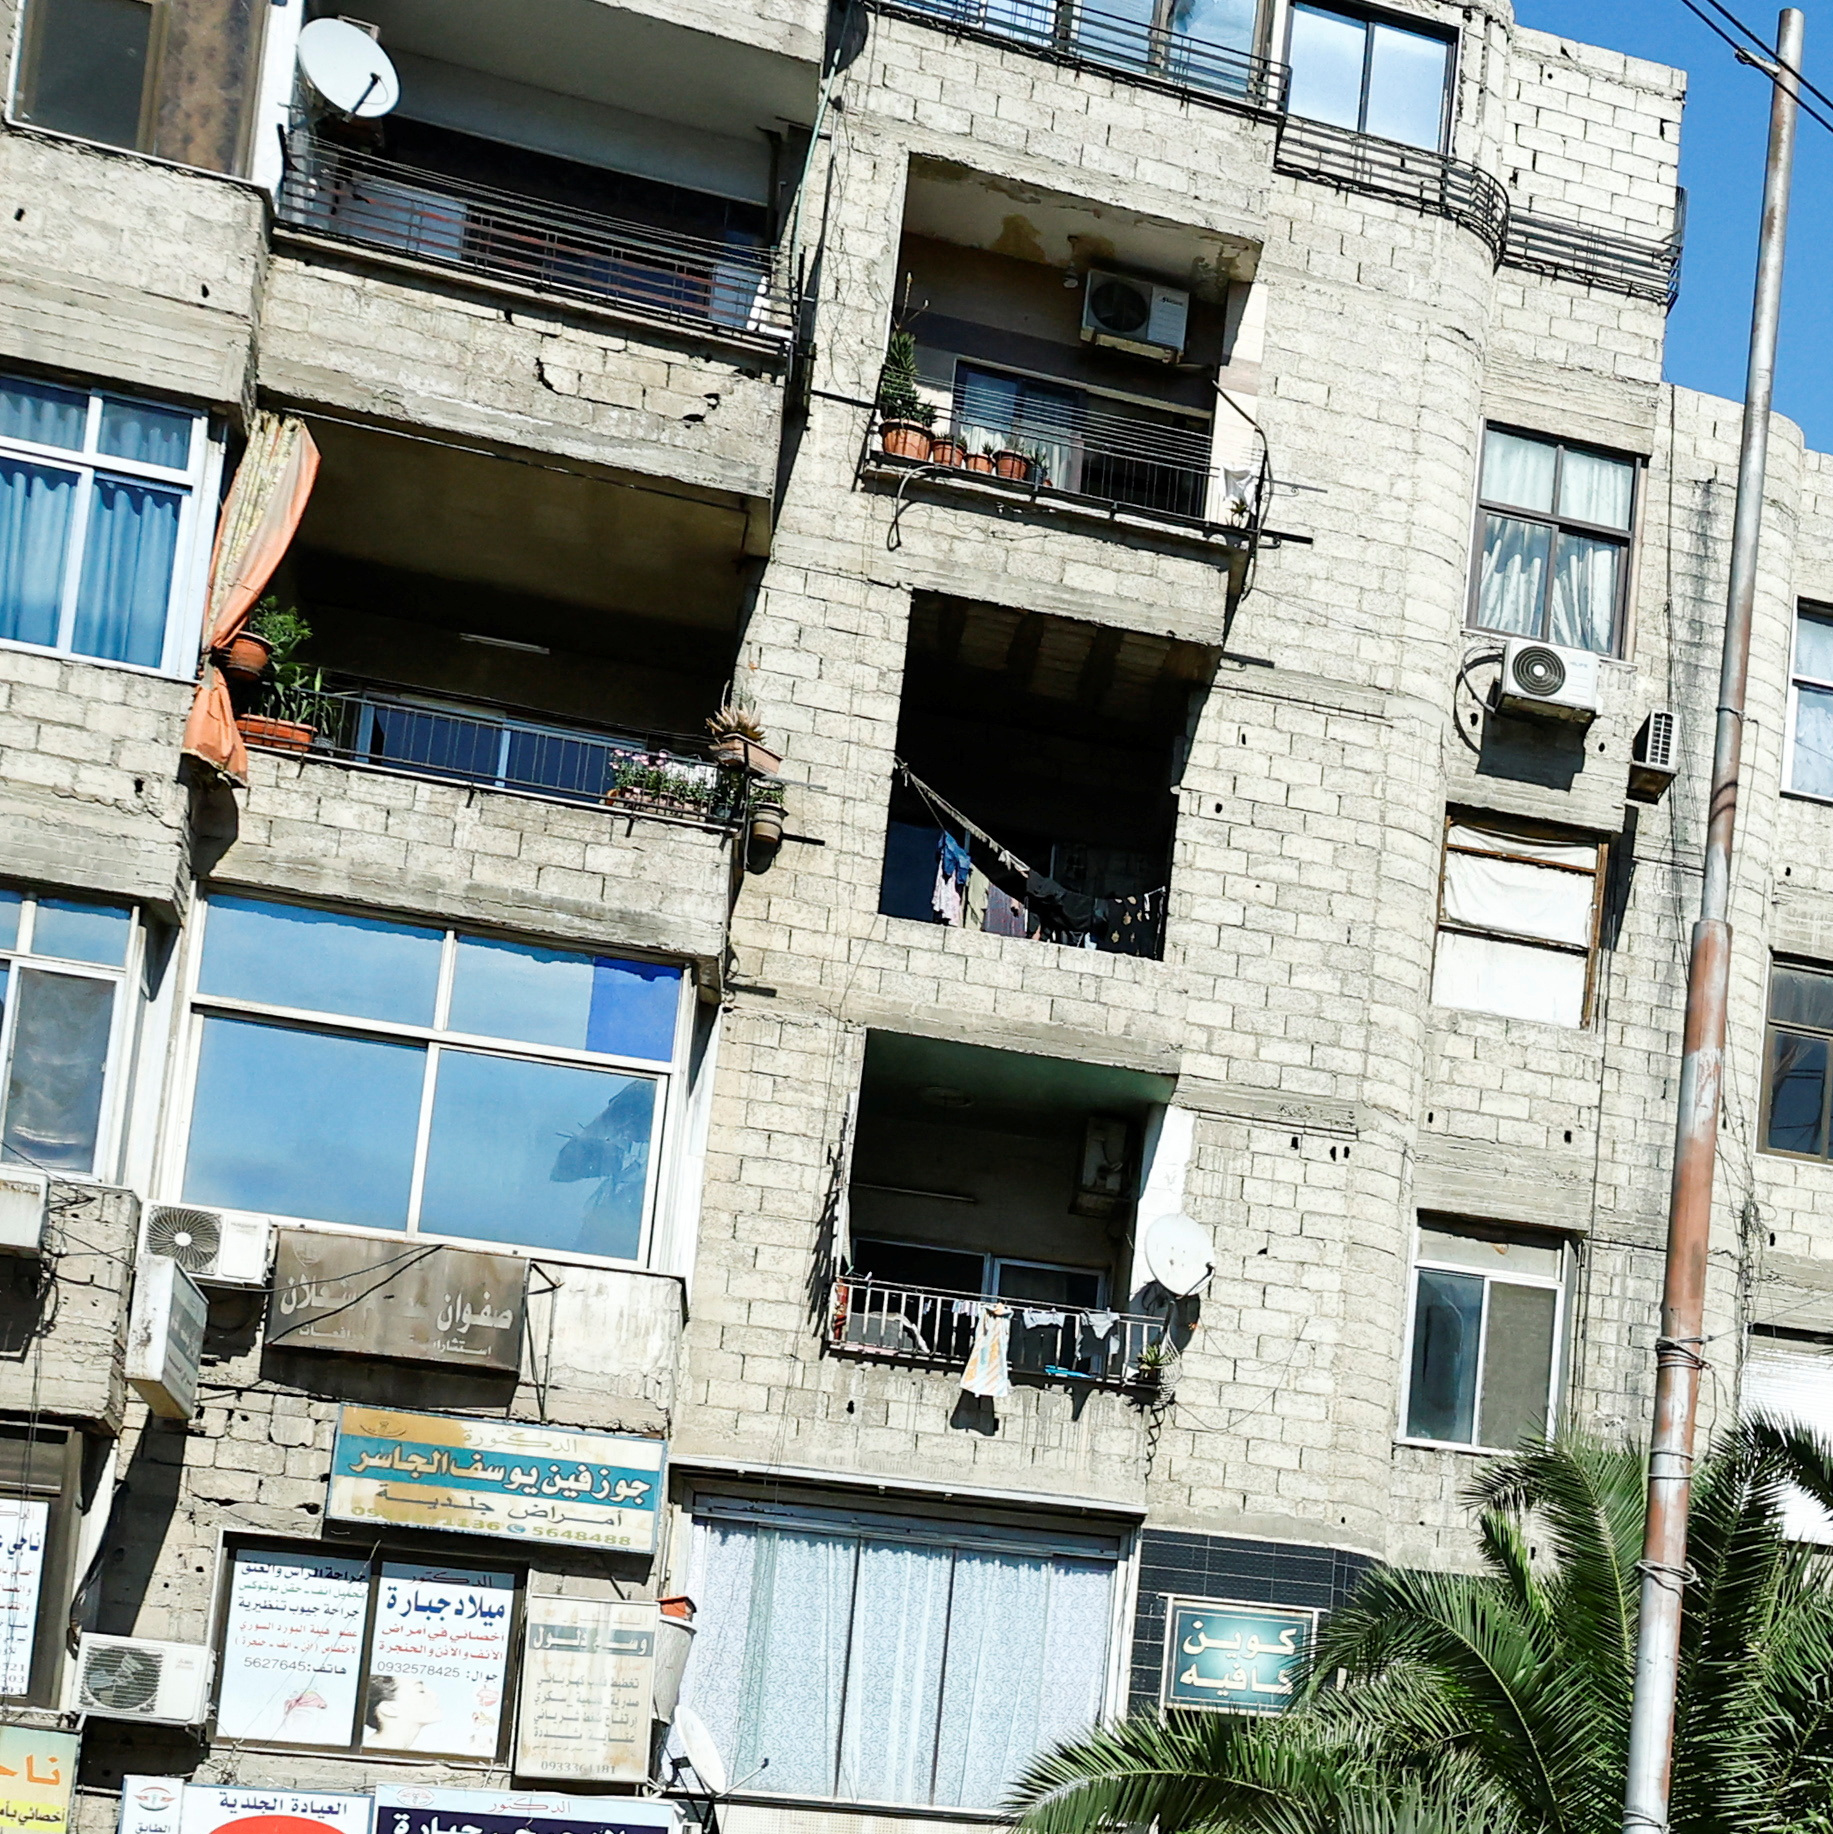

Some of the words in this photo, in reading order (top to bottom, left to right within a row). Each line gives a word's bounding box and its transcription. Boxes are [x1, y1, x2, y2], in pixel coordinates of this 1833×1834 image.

[437, 1290, 514, 1334] صفوان
[463, 1430, 577, 1453] الدكتورة
[350, 1442, 448, 1479] الجاسر
[450, 1452, 539, 1495] يوسف
[540, 1463, 651, 1505] جوزفين
[376, 1484, 494, 1515] جلدية
[507, 1504, 623, 1527] أمراض
[532, 1526, 631, 1546] 5648488
[325, 1567, 366, 1585] جراحة
[408, 1572, 492, 1588] الدكتور
[238, 1597, 287, 1613] تنظيرية
[289, 1605, 320, 1617] جيوب
[324, 1604, 359, 1620] جراحة
[387, 1586, 451, 1621] جبارة
[454, 1594, 505, 1626] ميلاد
[1183, 1621, 1297, 1660] كوين
[377, 1661, 460, 1677] 0932578425
[1180, 1663, 1294, 1696] كافيه
[219, 1791, 283, 1816] الجلدية
[291, 1795, 347, 1819] العيادة
[487, 1798, 571, 1814] الدكتور
[135, 1822, 171, 1834] الطابق
